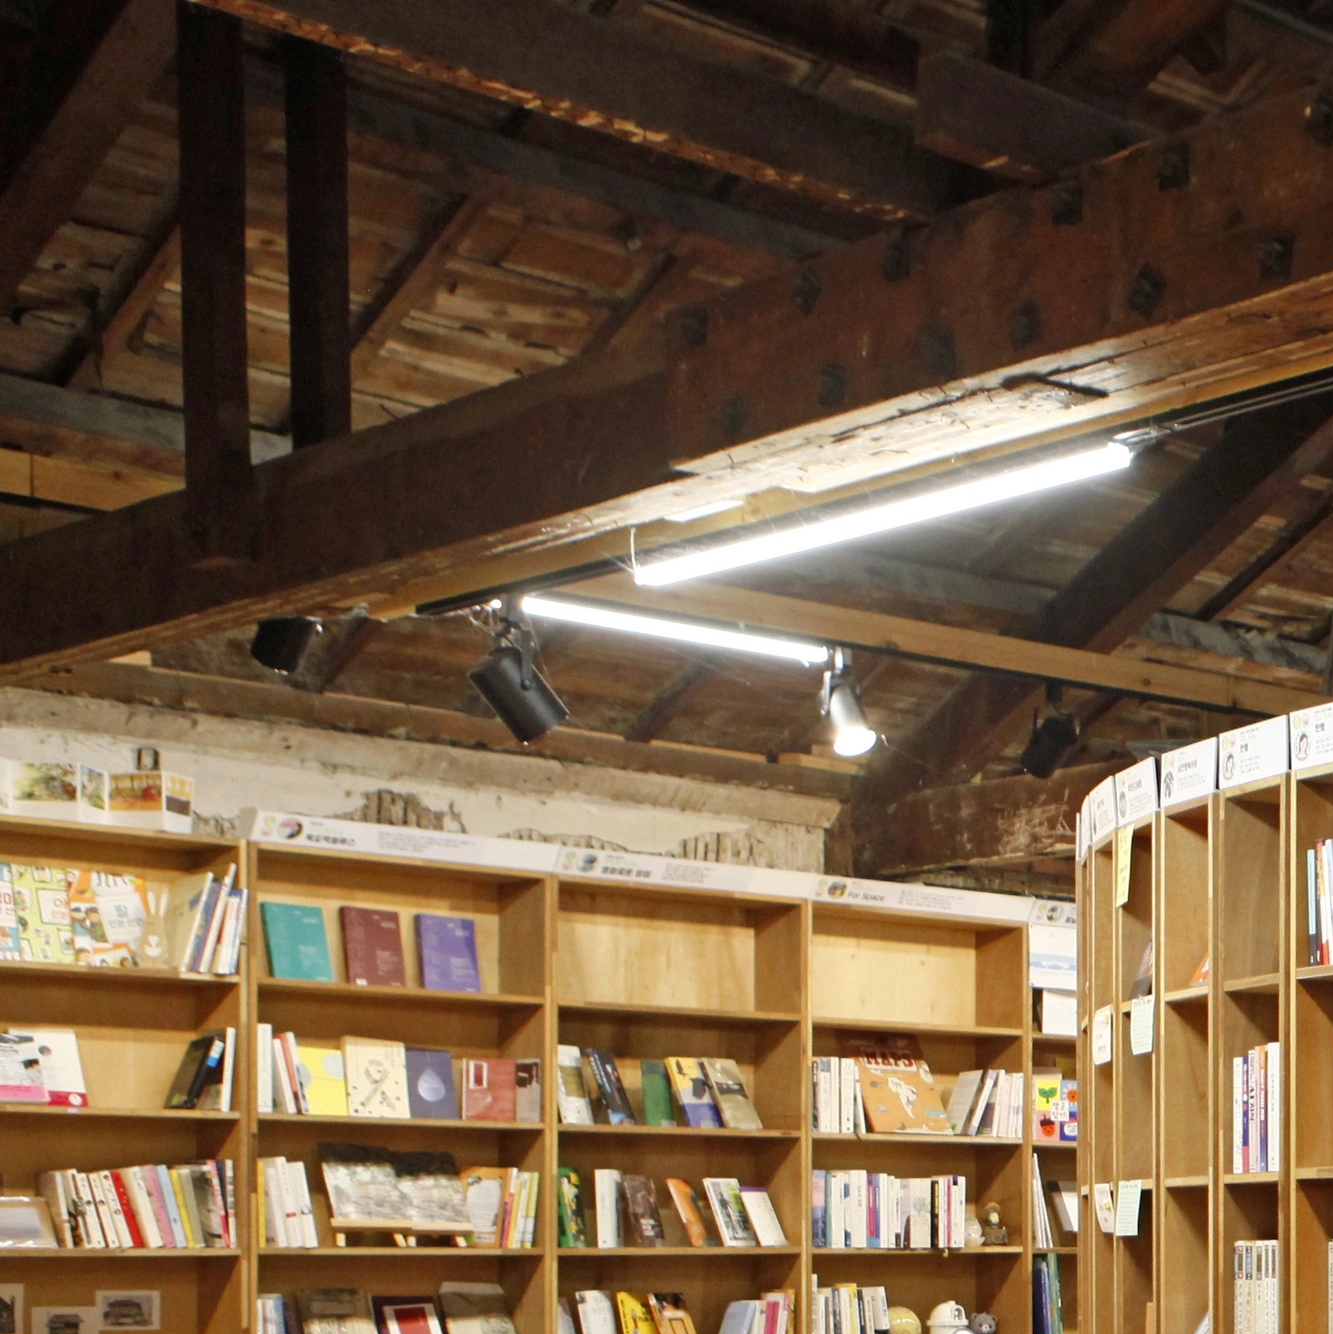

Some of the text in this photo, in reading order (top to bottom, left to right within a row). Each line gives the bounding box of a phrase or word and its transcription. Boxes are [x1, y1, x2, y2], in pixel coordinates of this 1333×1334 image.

[847, 890, 886, 903] For Space
[864, 1049, 916, 1069] MAPS
